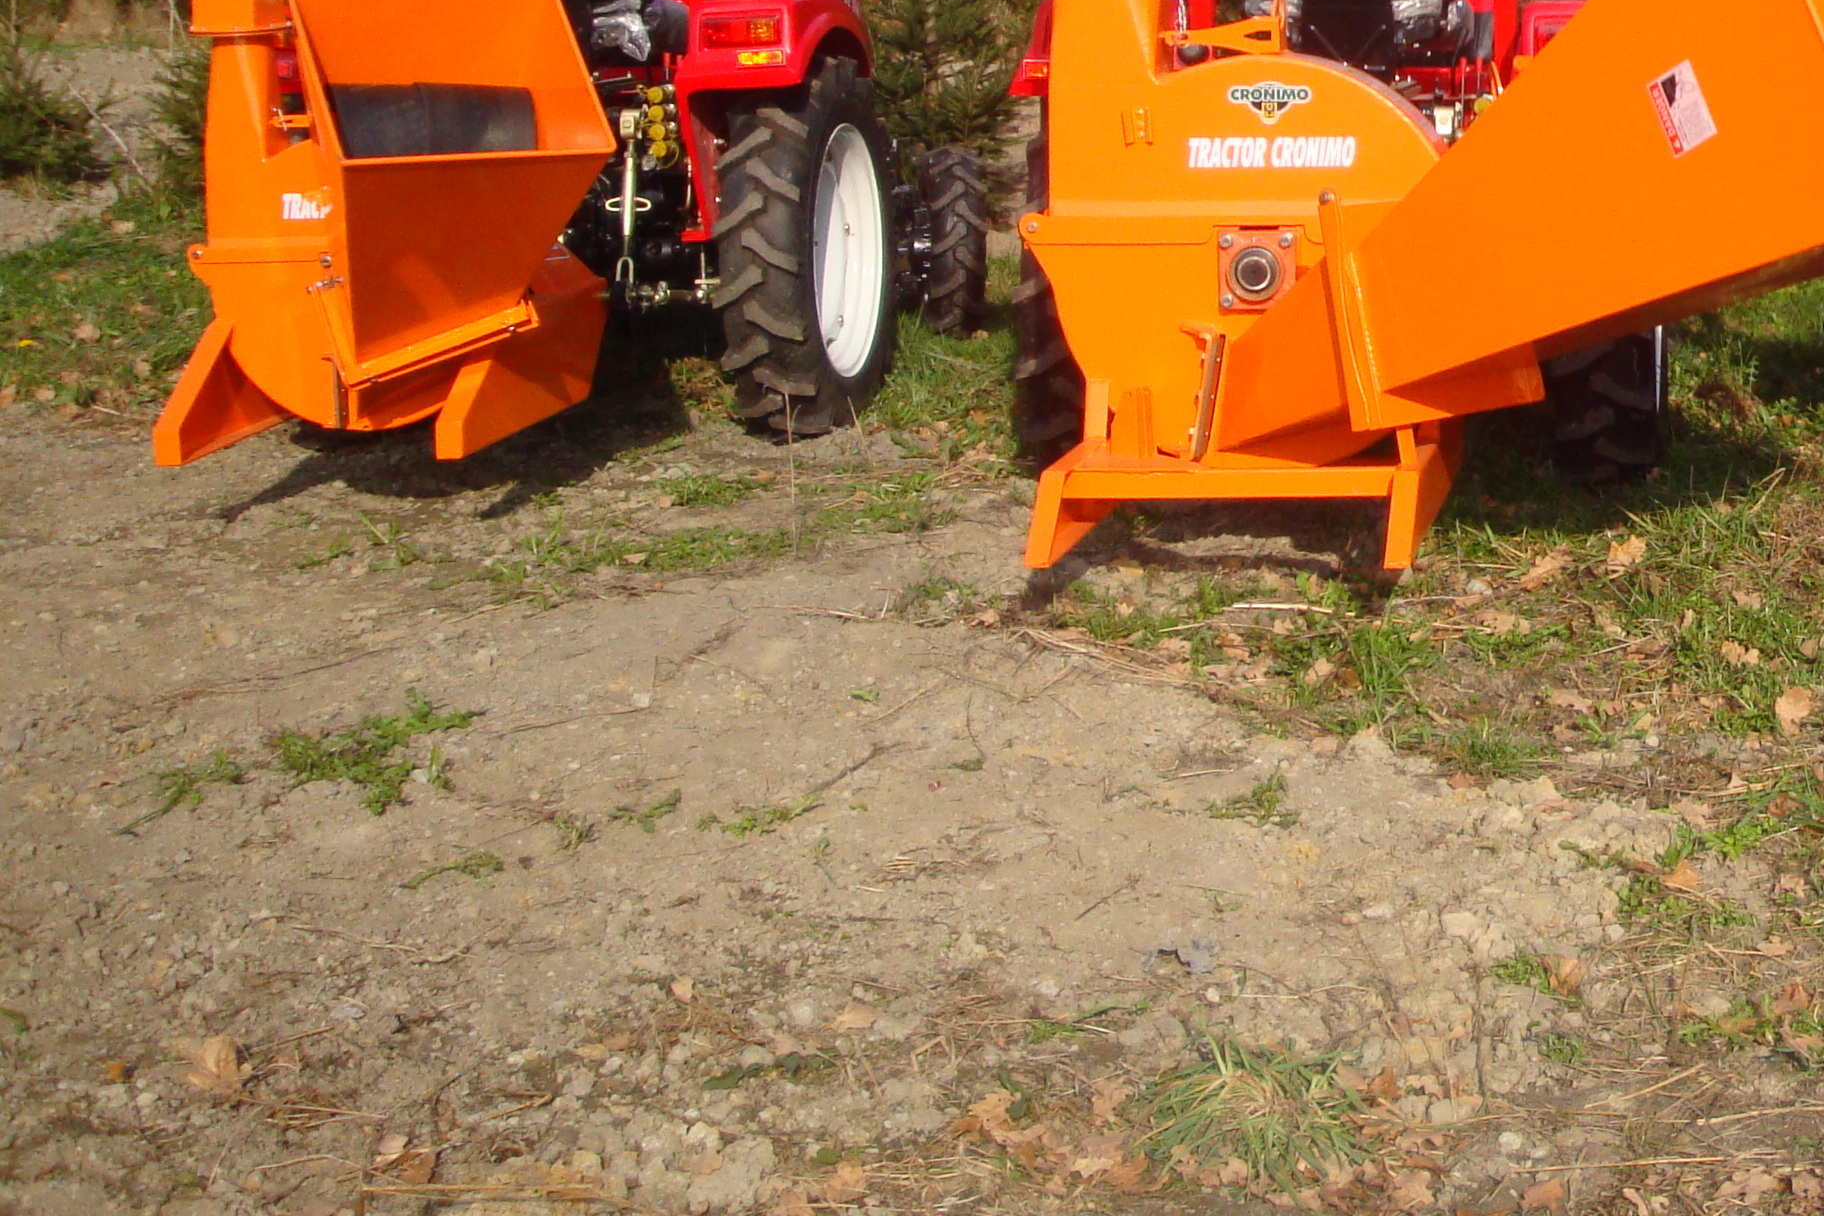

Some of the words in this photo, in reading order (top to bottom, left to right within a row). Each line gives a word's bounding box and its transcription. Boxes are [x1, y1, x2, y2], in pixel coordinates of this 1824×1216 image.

[1231, 89, 1308, 100] CRONIMO
[1188, 137, 1267, 168] TRACTOR
[1271, 136, 1356, 168] CRONIMO
